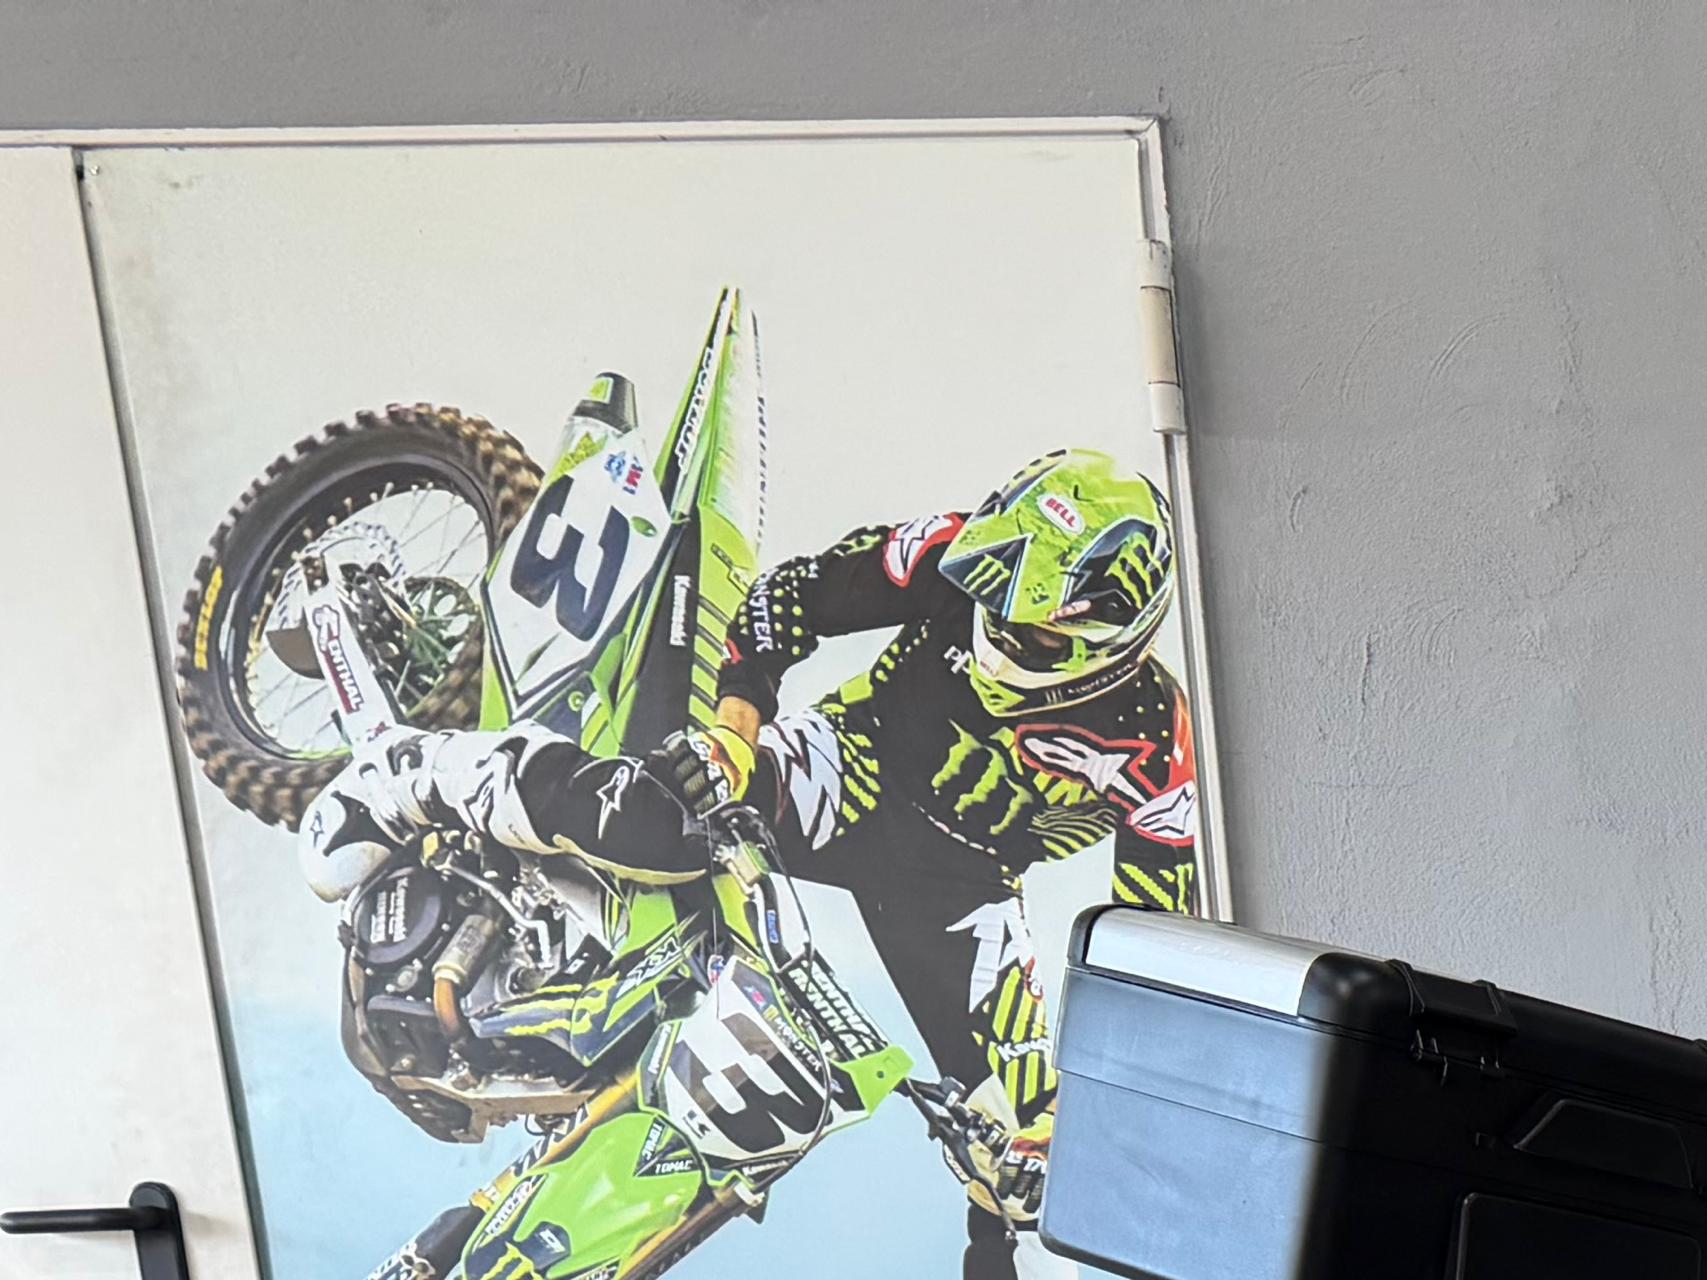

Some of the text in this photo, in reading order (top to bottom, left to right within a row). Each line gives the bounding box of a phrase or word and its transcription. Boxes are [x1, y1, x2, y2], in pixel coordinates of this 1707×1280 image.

[510, 474, 629, 643] 3
[1044, 498, 1076, 528] BELL
[668, 1012, 832, 1154] 3
